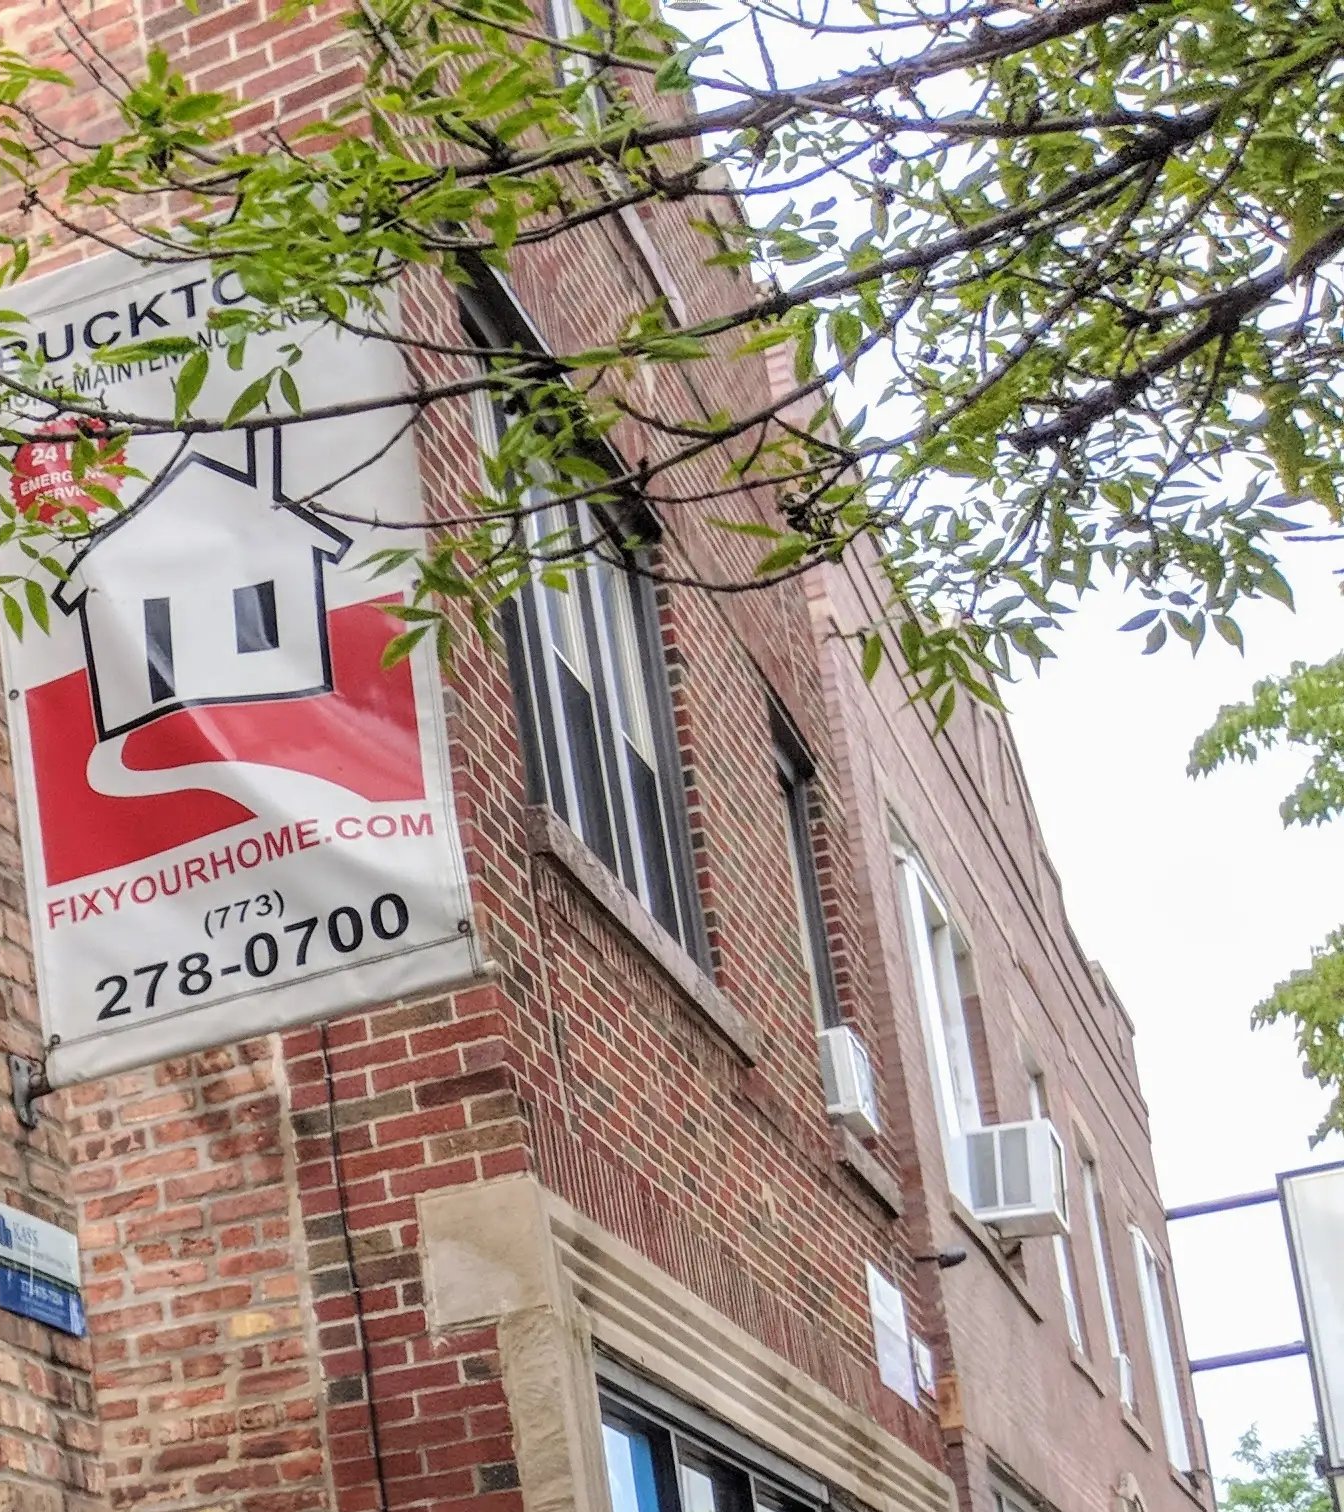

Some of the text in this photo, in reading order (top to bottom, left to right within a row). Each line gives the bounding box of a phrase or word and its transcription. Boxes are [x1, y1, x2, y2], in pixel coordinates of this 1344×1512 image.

[31, 447, 58, 466] 24
[47, 813, 434, 929] FIXYOURHOME.COM
[204, 889, 284, 938] (773)
[95, 892, 410, 1021] 278-0700
